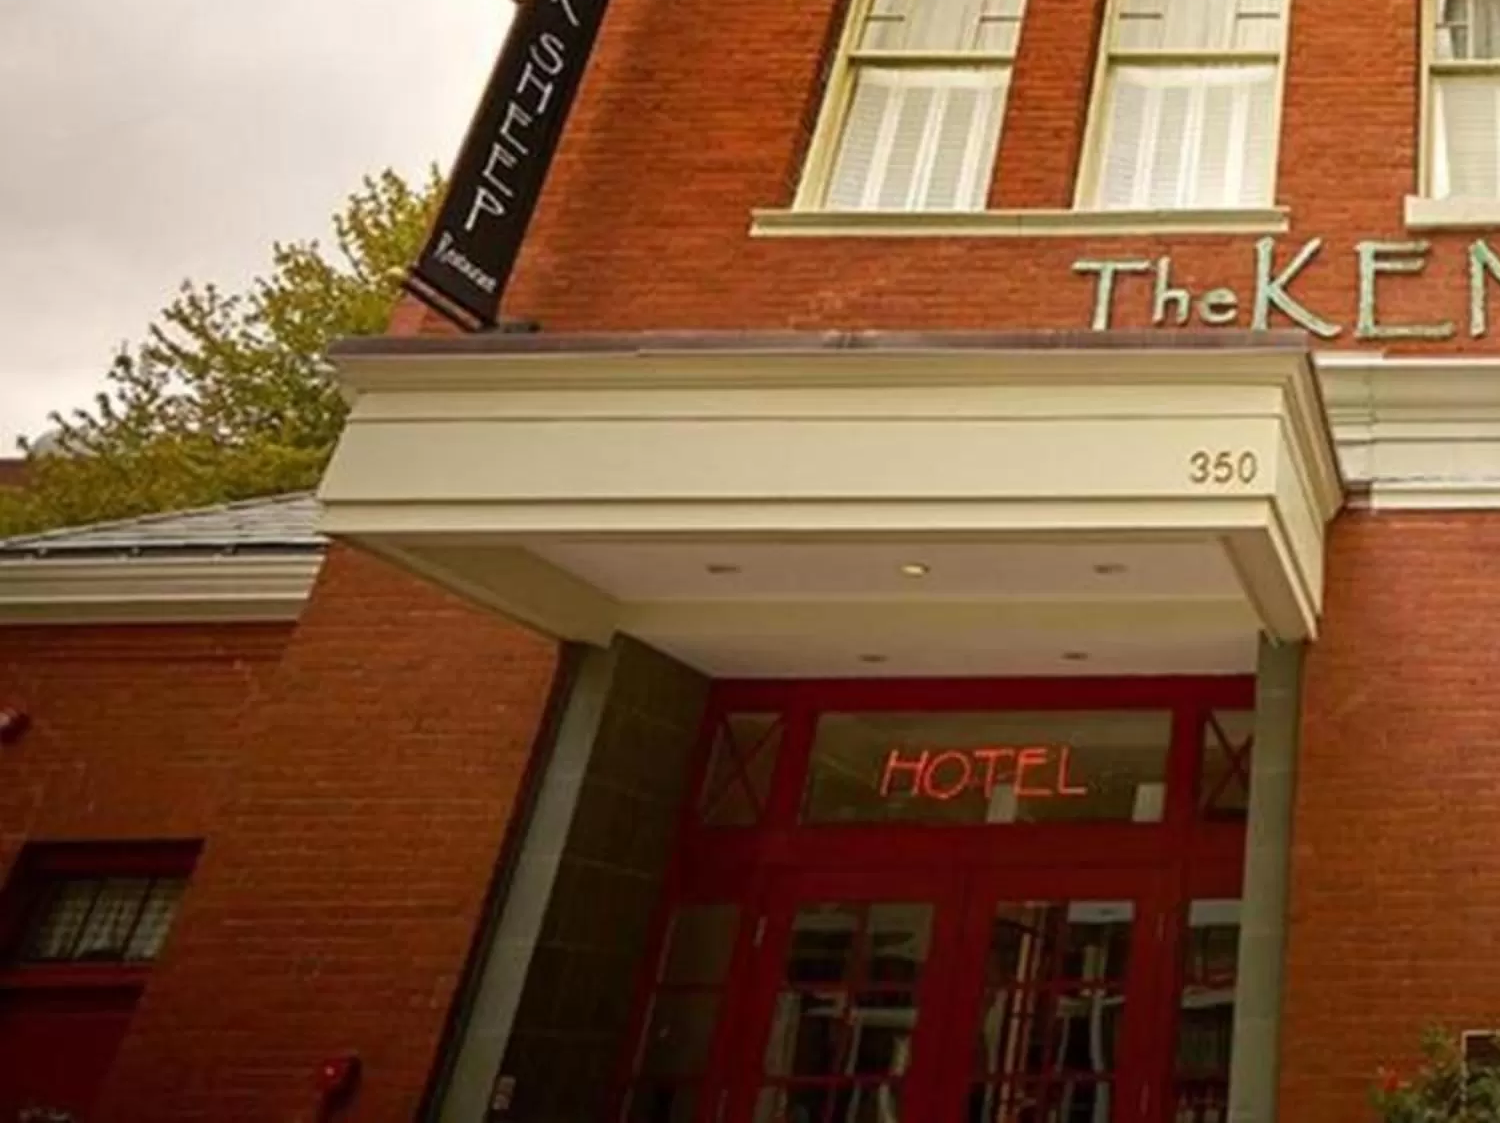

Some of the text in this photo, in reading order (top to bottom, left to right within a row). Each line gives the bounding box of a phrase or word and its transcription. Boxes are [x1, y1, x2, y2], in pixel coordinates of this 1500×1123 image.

[465, 32, 563, 230] SHEEP
[1071, 256, 1238, 332] The
[1188, 449, 1258, 484] 350
[880, 747, 1087, 799] HOTEL
